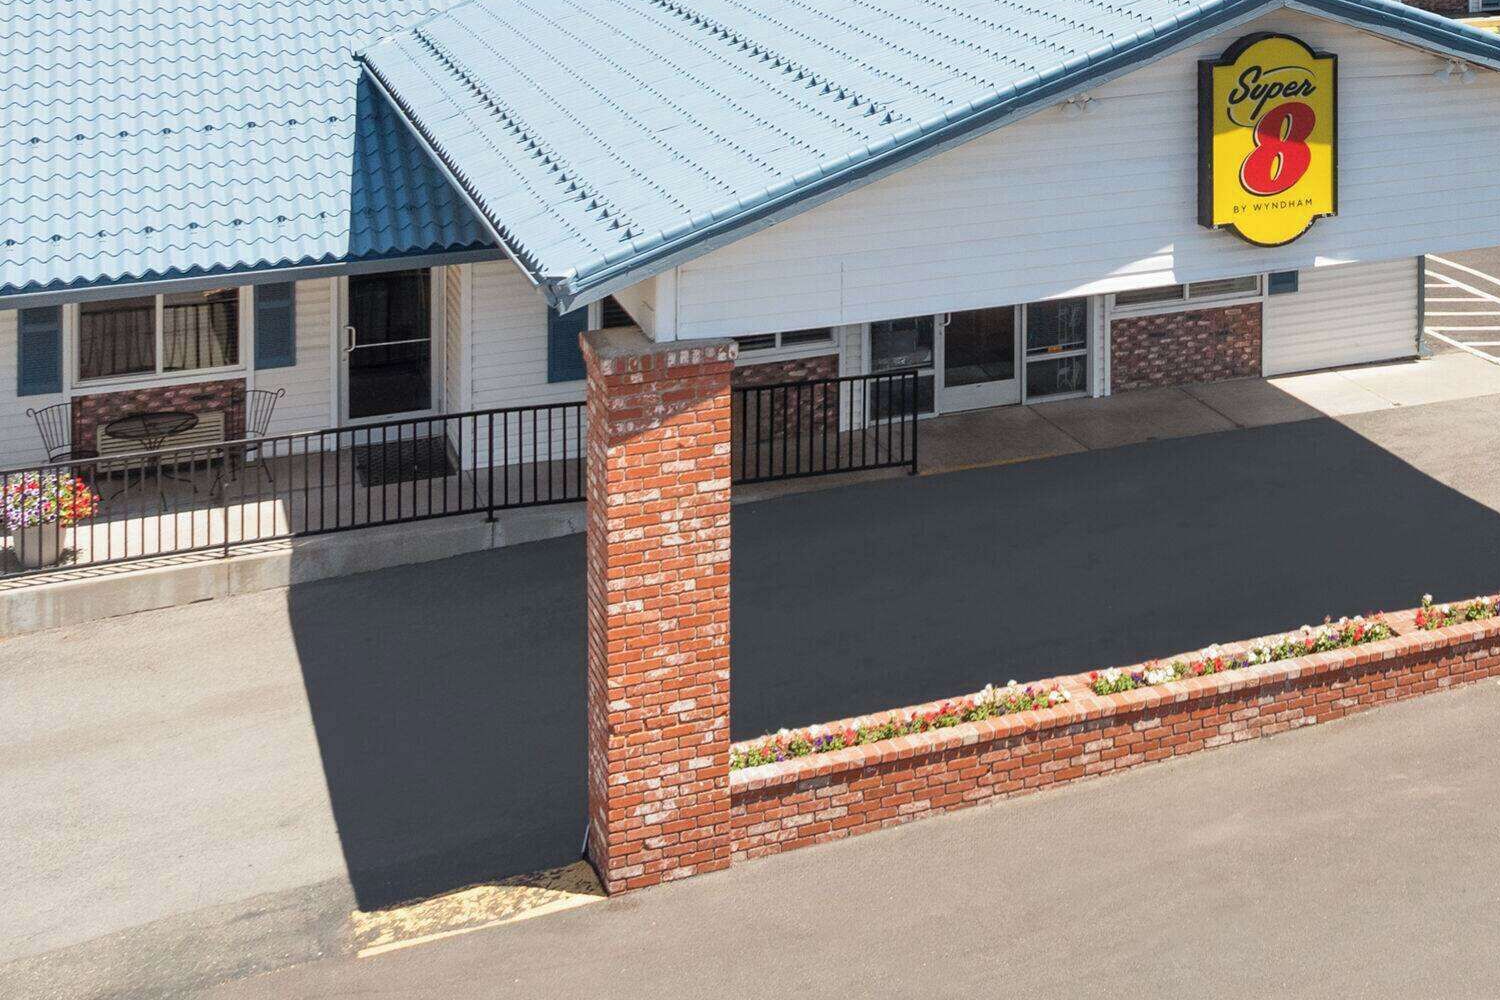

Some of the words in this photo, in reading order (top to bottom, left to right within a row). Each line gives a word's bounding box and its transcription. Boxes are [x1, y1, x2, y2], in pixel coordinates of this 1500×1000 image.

[1228, 65, 1316, 120] Super
[1239, 102, 1316, 197] 8
[1233, 205, 1247, 214] BY
[1253, 198, 1313, 212] WYNDHAM
